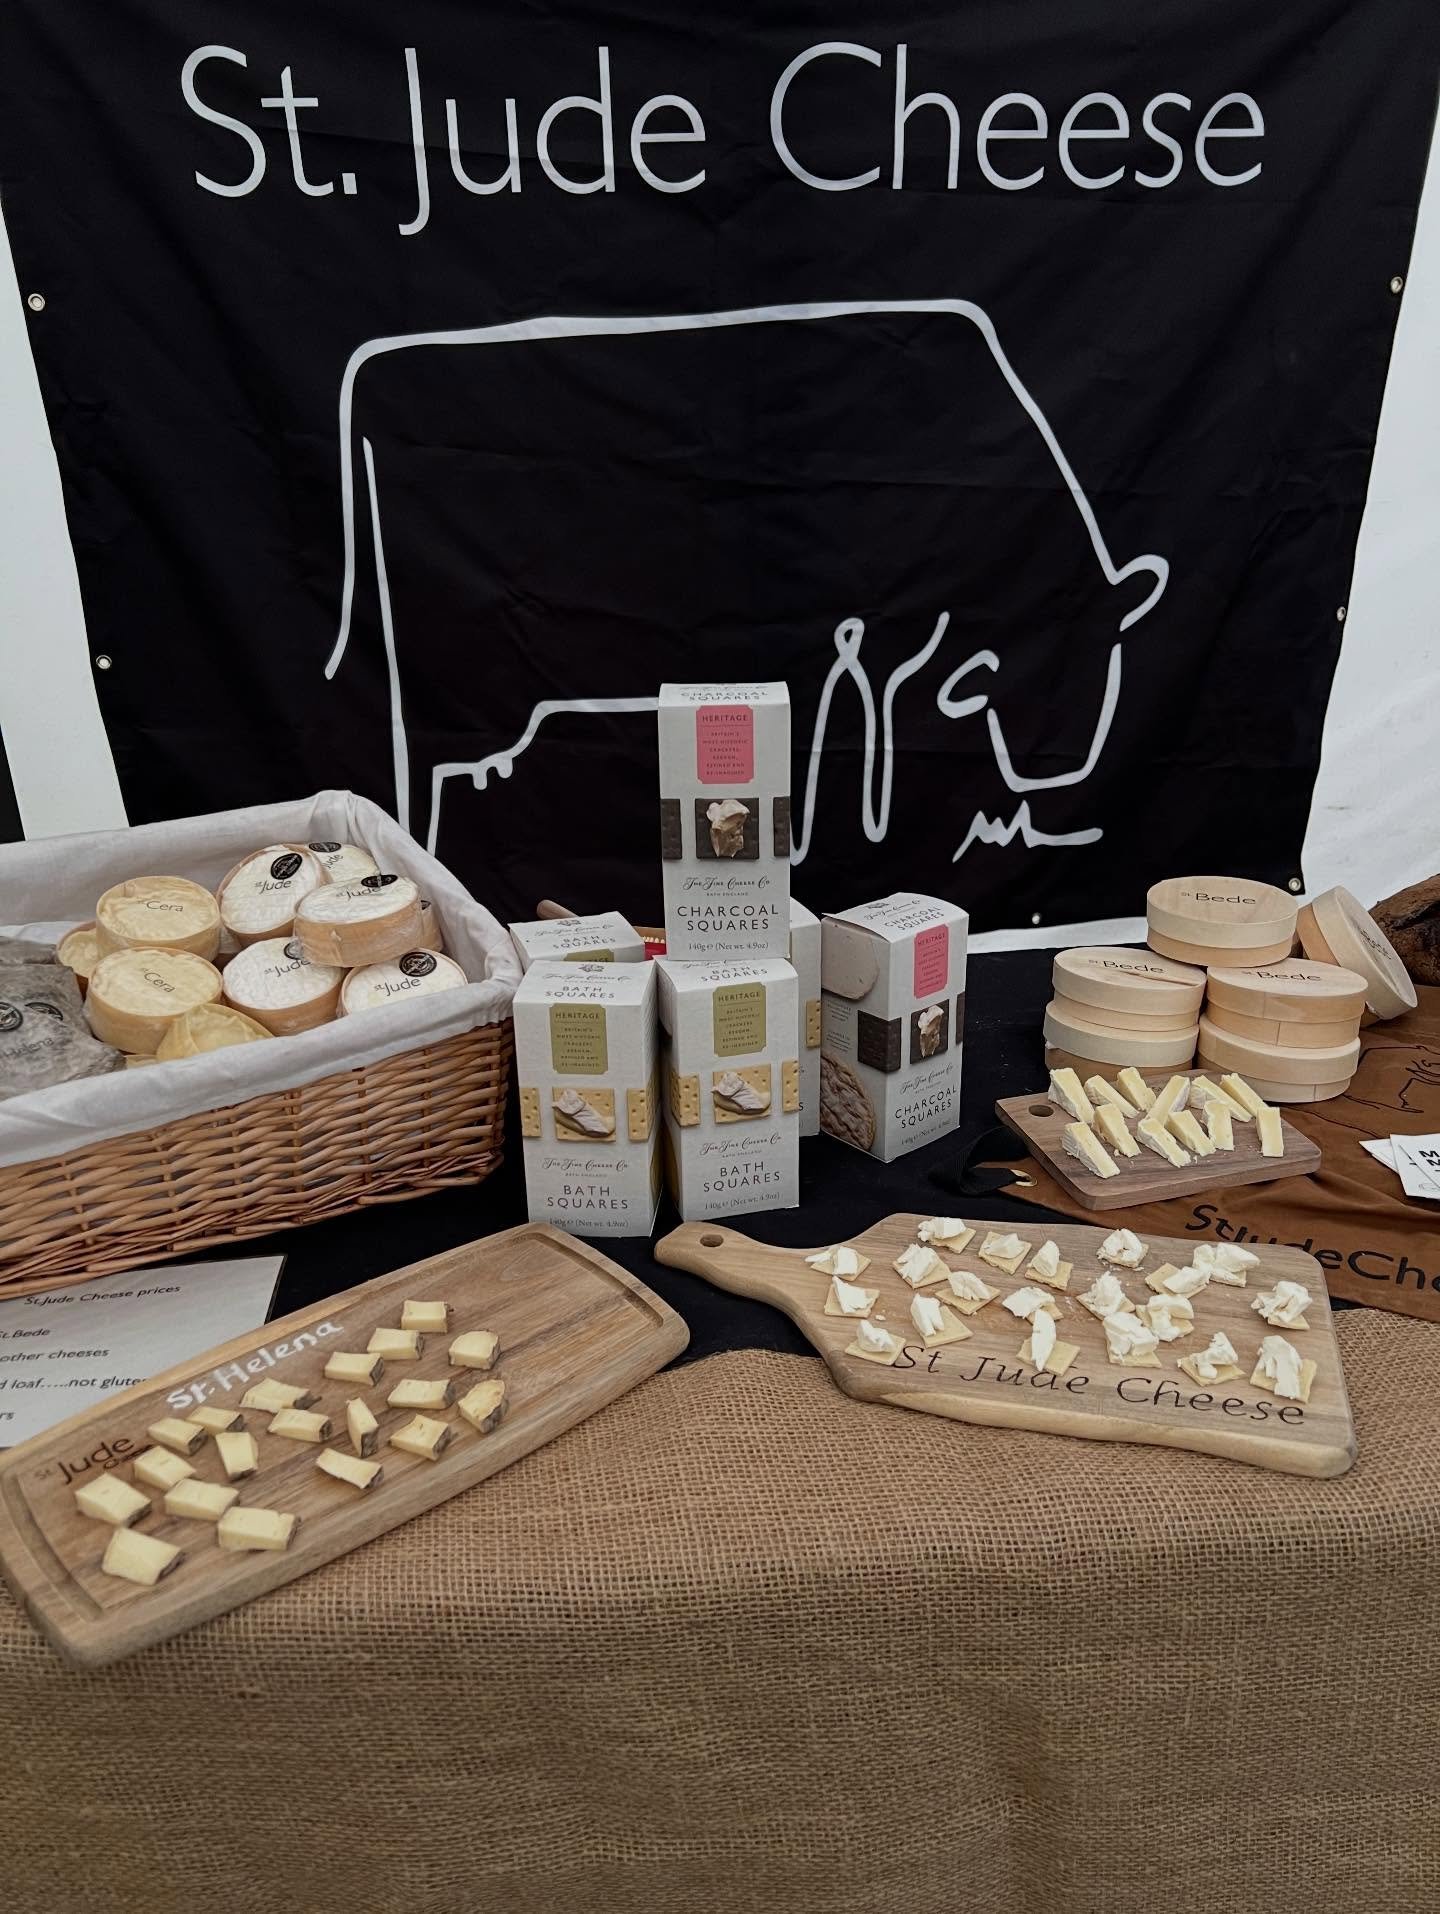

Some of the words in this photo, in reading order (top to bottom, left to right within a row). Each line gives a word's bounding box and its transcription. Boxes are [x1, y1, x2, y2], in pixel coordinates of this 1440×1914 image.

[181, 44, 358, 197] St.
[398, 44, 707, 236] Jude
[769, 41, 1266, 191] Cheese
[702, 714, 747, 722] HERITAGE
[259, 879, 292, 894] Jude
[1195, 892, 1257, 905] Bede
[146, 900, 184, 912] Cera
[677, 904, 779, 917] CHARCOAL
[687, 918, 769, 932] SQUARES
[553, 938, 616, 949] SQUARES
[563, 935, 600, 943] BATH
[712, 966, 750, 975] BATH
[1102, 960, 1166, 974] Bede
[700, 969, 768, 981] SQUARES
[1256, 970, 1322, 981] Bede
[144, 972, 176, 993] Cera
[385, 977, 422, 997] Jude
[544, 991, 615, 999] SQUARES
[718, 991, 760, 1002] HERITAGE
[894, 1084, 957, 1119] CHARCOAL
[901, 1099, 952, 1129] SQUARES
[720, 1161, 764, 1177] BATH
[703, 1171, 780, 1193] SQUARES
[563, 1185, 610, 1196] BATH
[547, 1196, 628, 1210] SQUARES
[80, 1291, 133, 1302] Cheese
[137, 1285, 181, 1299] prices
[0, 1351, 44, 1362] other
[48, 1349, 110, 1360] cheeses
[891, 1344, 943, 1374] St
[958, 1355, 1090, 1395] Jude
[1116, 1375, 1306, 1426] Cheese
[57, 1436, 135, 1485] Jude
